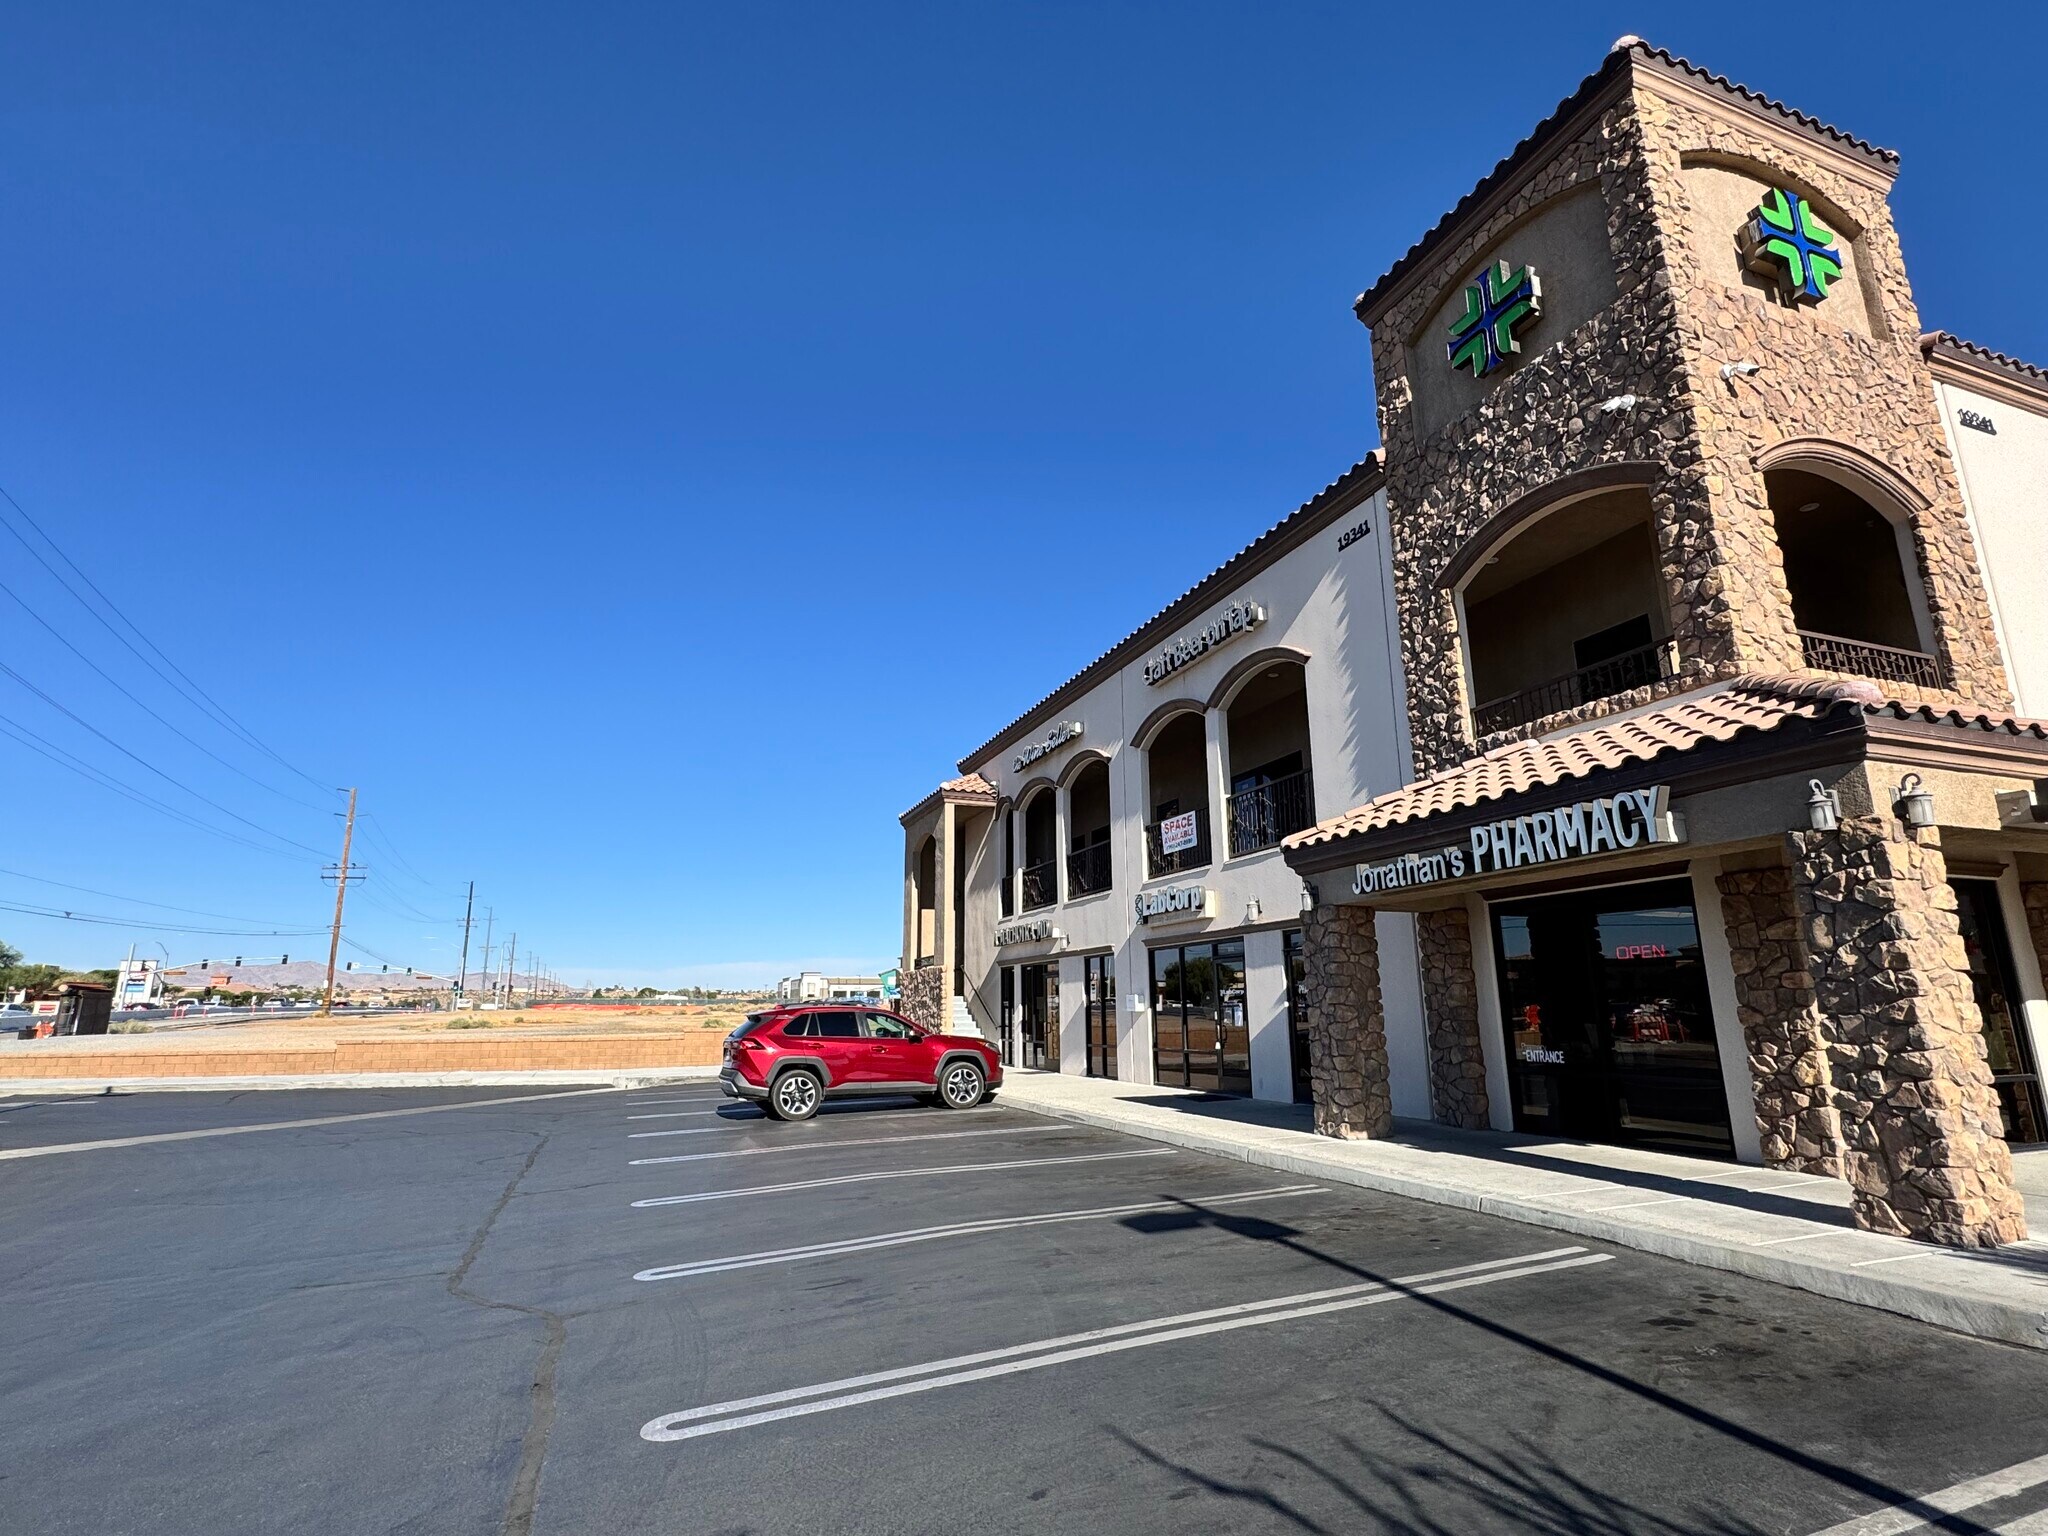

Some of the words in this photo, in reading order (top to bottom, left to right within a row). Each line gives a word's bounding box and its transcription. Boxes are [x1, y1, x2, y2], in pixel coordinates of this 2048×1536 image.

[1957, 408, 1996, 435] 19341
[1337, 519, 1370, 552] 19341
[1142, 650, 1173, 686] Craft
[1173, 636, 1204, 669] Beer
[1205, 621, 1226, 646] on
[1224, 601, 1253, 632] Tap
[1164, 814, 1193, 835] SPACE
[1164, 828, 1194, 844] AVAILABLE
[1352, 848, 1465, 895] Jonathan's
[1470, 785, 1661, 873] PHARMACY
[1143, 886, 1201, 916] LabCorp
[1616, 944, 1666, 960] OPEN
[1526, 1050, 1565, 1064] ENTRANCE
